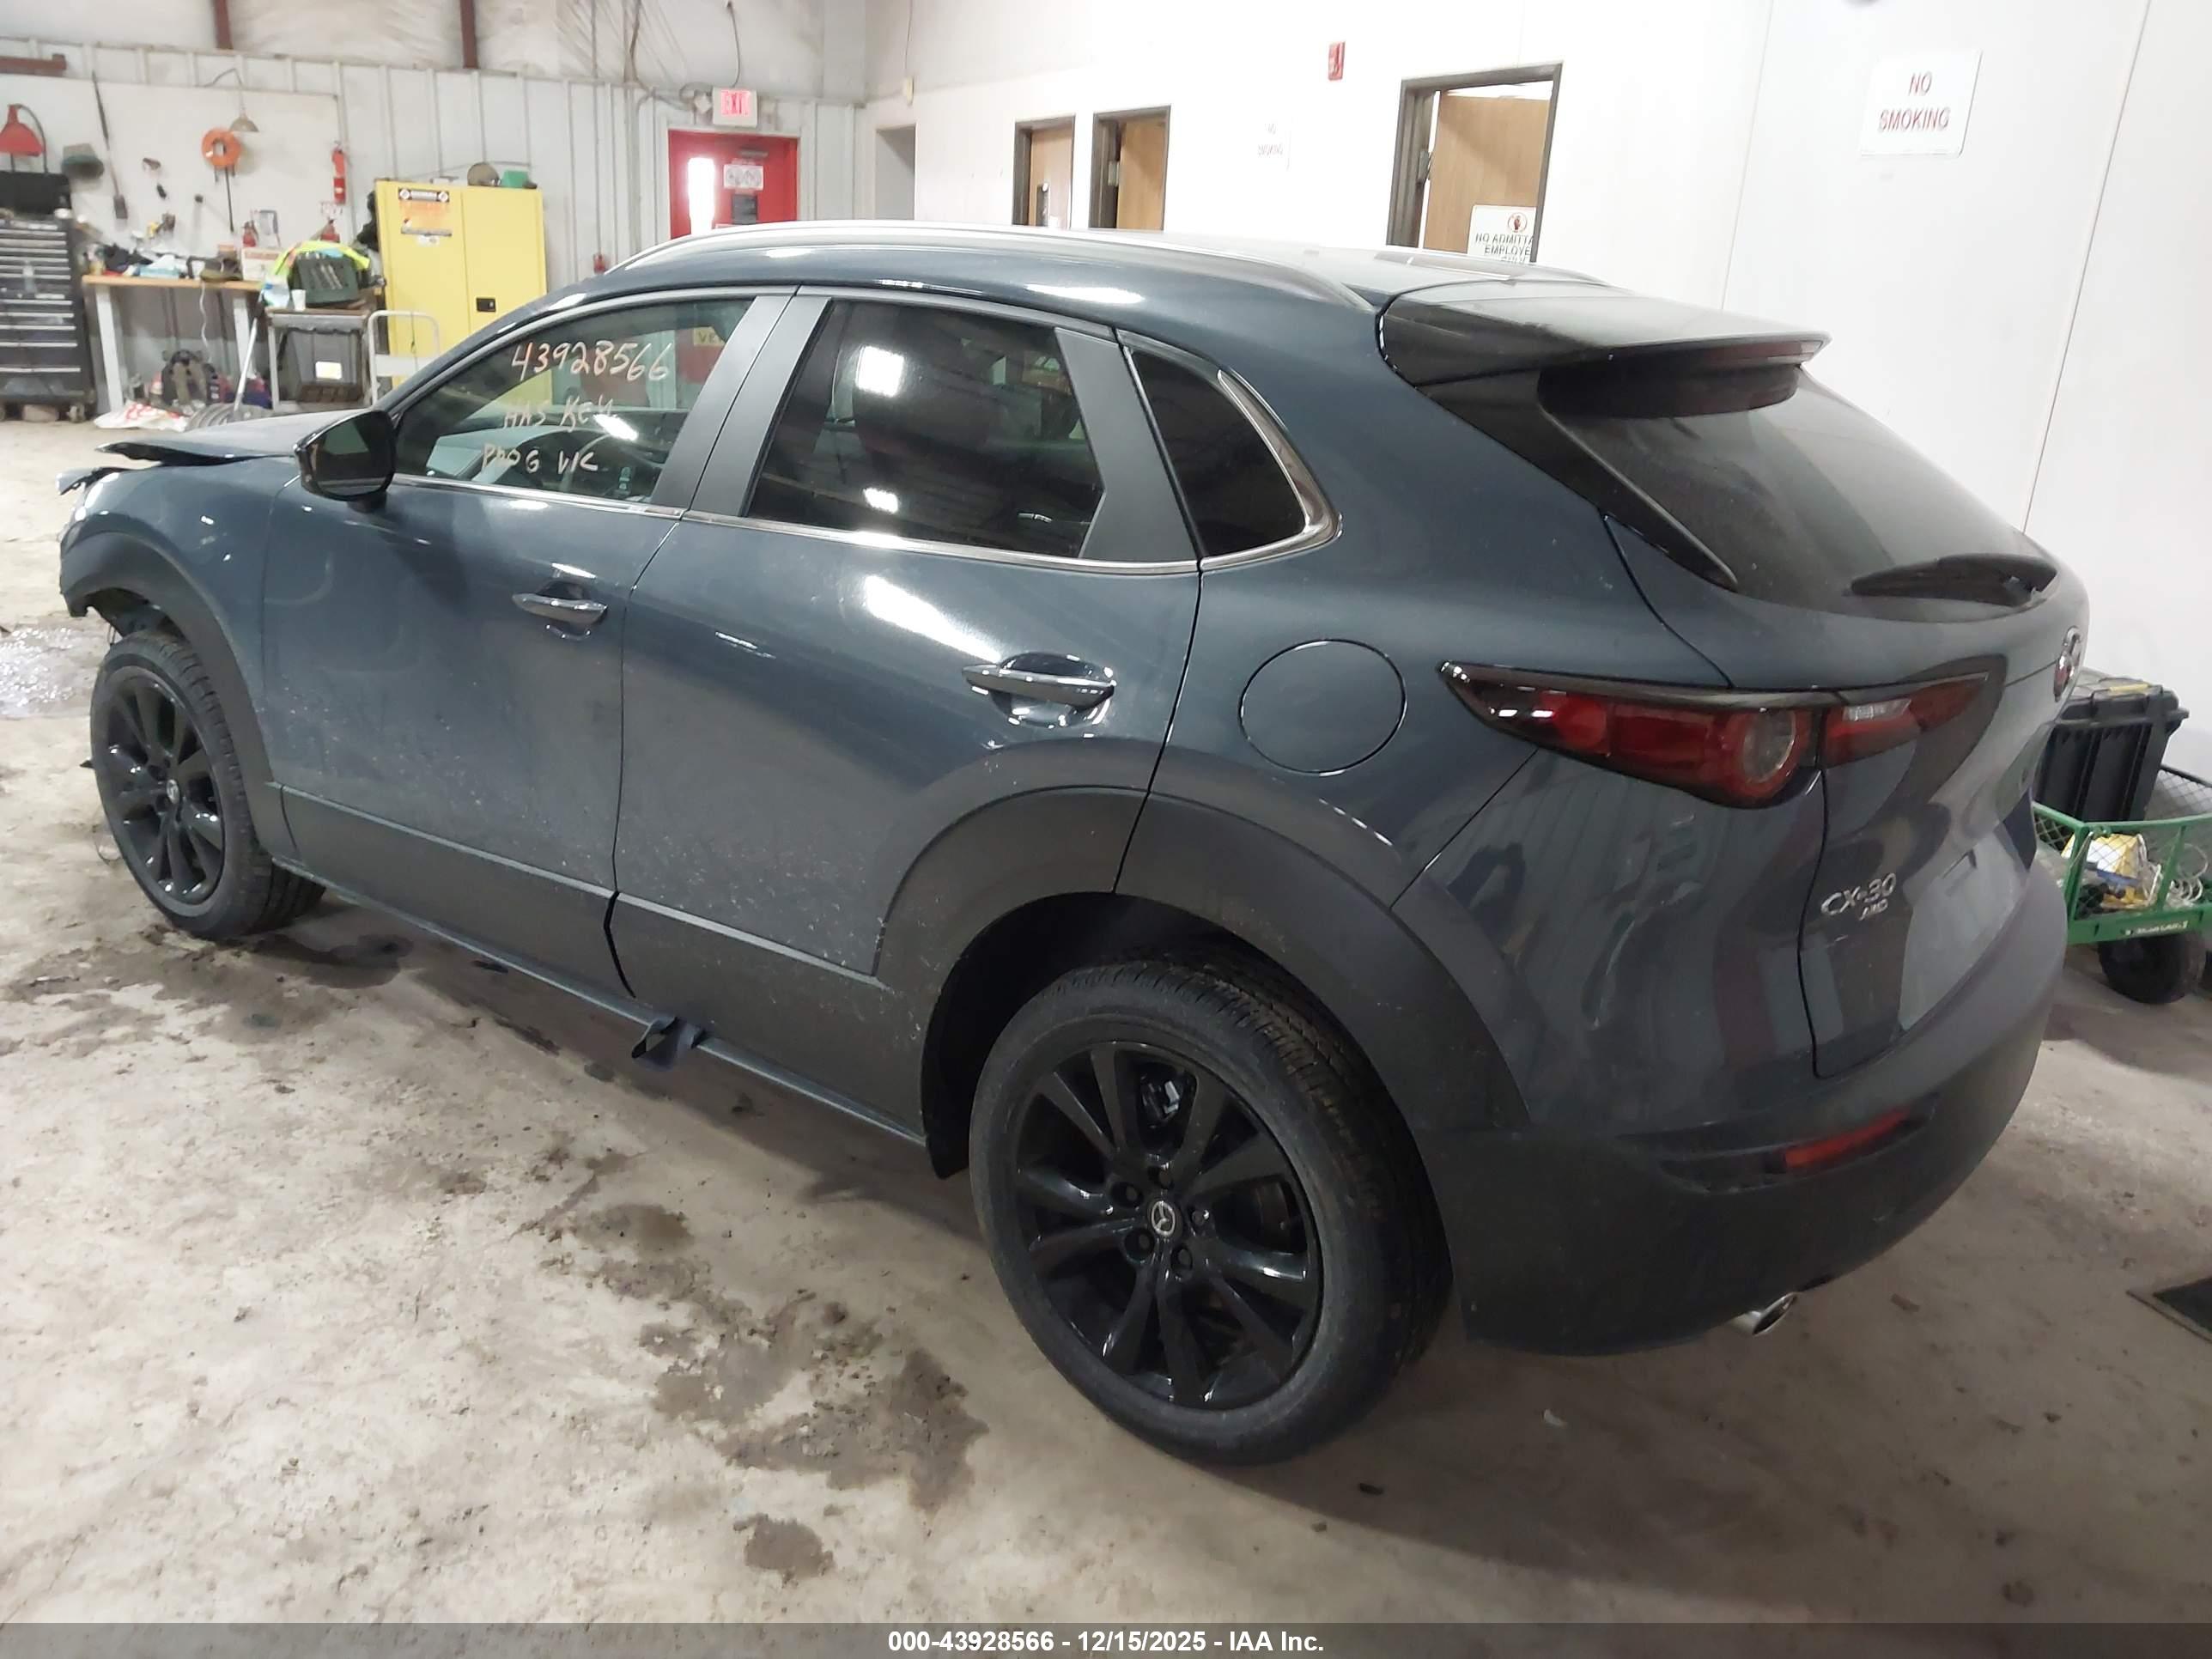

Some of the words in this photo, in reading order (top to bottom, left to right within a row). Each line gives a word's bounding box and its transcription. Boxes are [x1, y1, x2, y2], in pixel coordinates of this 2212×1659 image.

[1907, 70, 1932, 96] NO
[720, 90, 751, 115] EXIT
[1878, 106, 1950, 132] SMOKING
[1475, 233, 1490, 243] NO
[511, 340, 672, 382] 43928566
